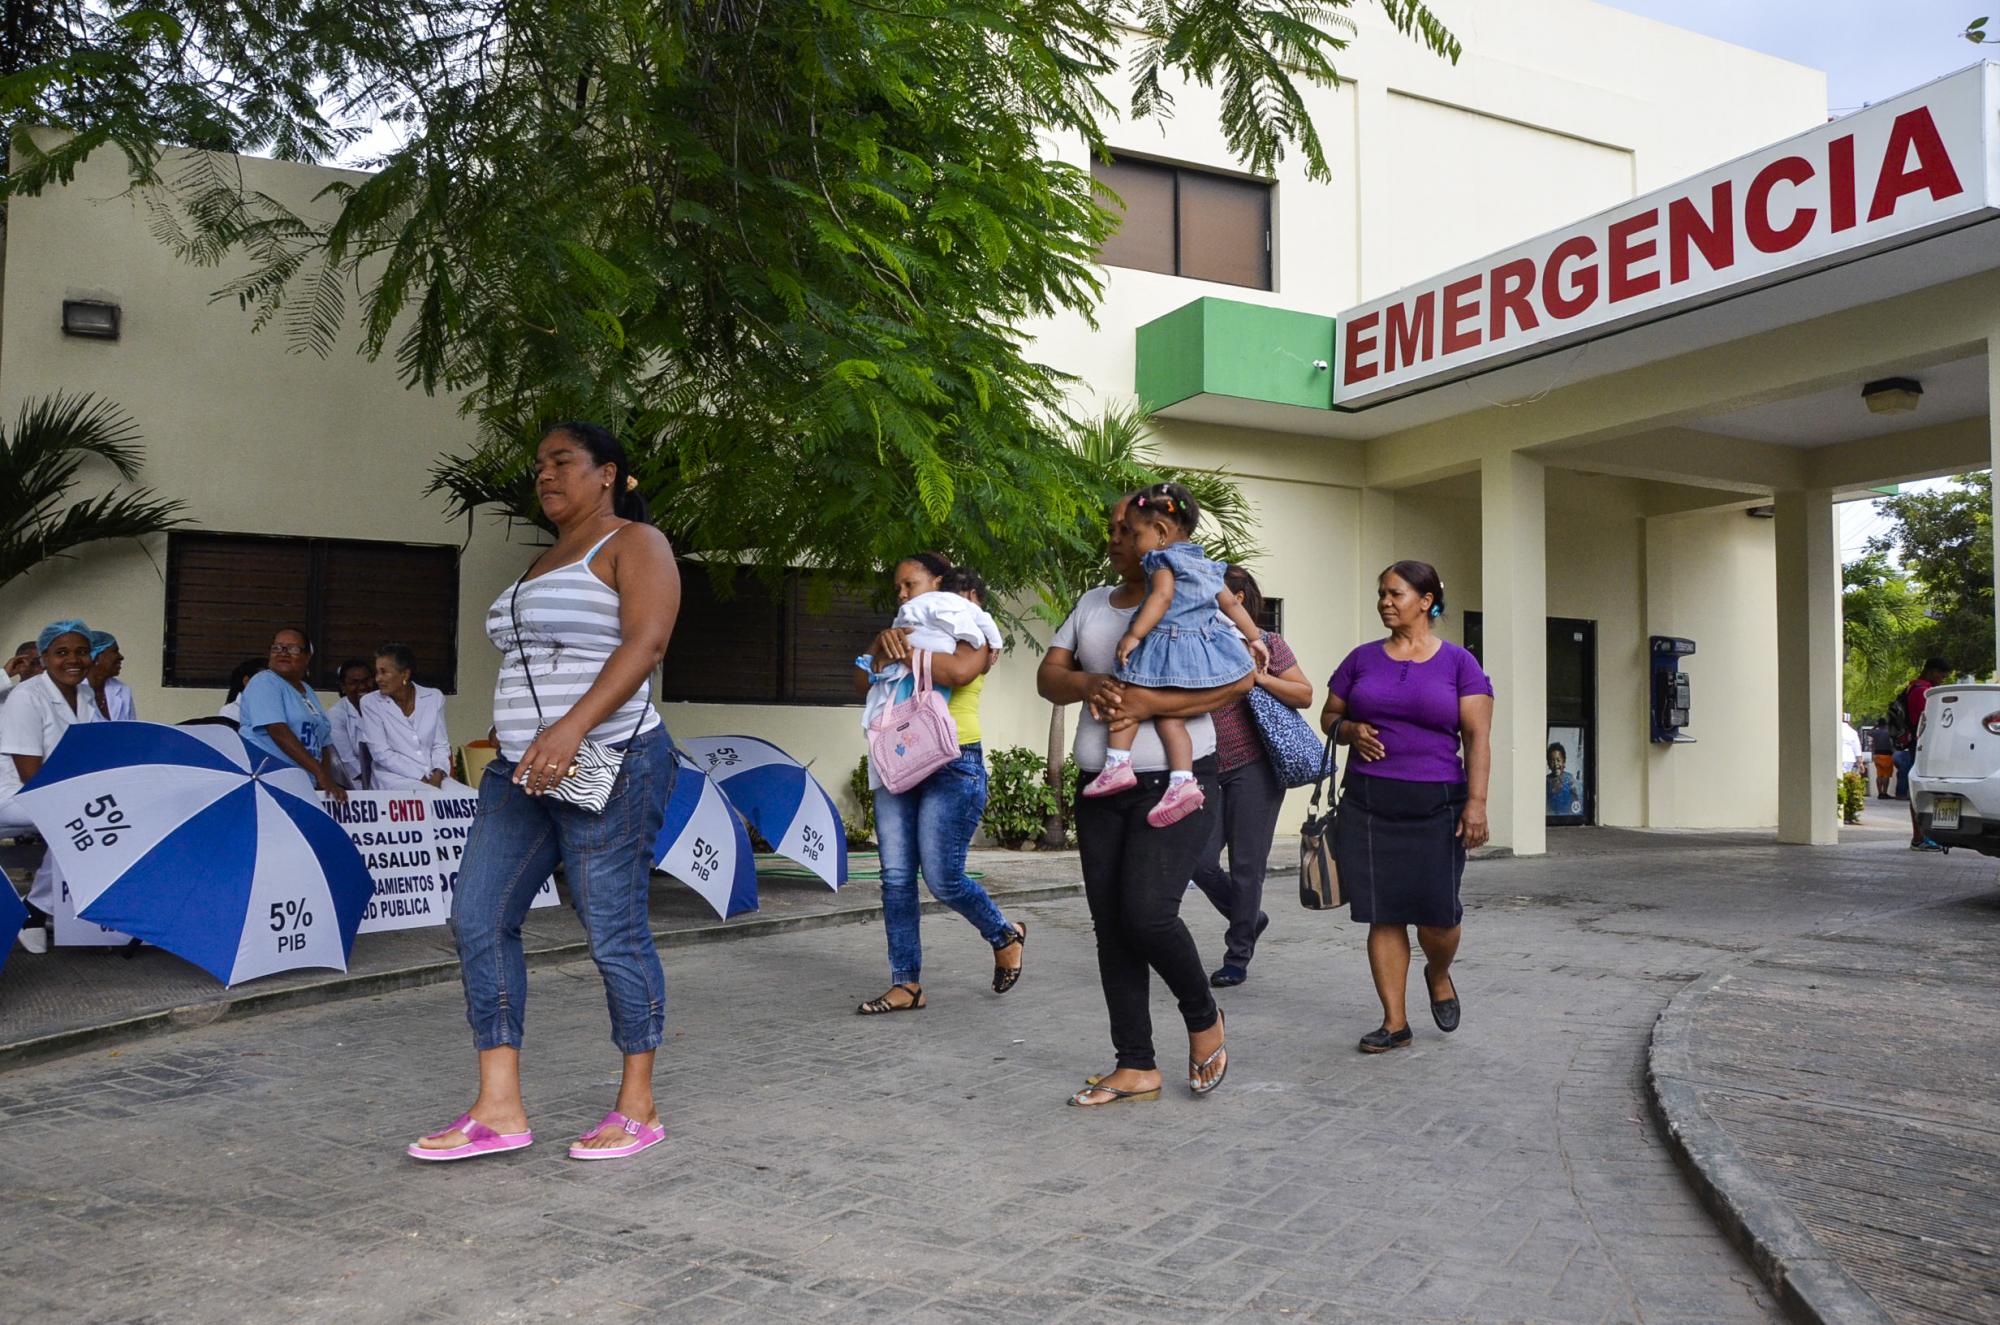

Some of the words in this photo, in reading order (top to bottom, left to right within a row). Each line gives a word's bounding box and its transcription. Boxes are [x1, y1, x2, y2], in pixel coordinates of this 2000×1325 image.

[1344, 106, 1963, 385] EMERGENCIA
[717, 747, 742, 766] 5%
[84, 793, 132, 847] 5%
[388, 799, 425, 822] CNTD
[433, 798, 479, 820] UNASE
[65, 817, 94, 852] PIB
[802, 824, 825, 852] 5%
[361, 850, 431, 870] ASALUD
[692, 837, 719, 871] 5%
[803, 845, 819, 861] PIB
[691, 861, 710, 881] PIB
[270, 897, 313, 932] 5%
[380, 896, 431, 918] PUBLICA
[278, 933, 306, 953] PIB
